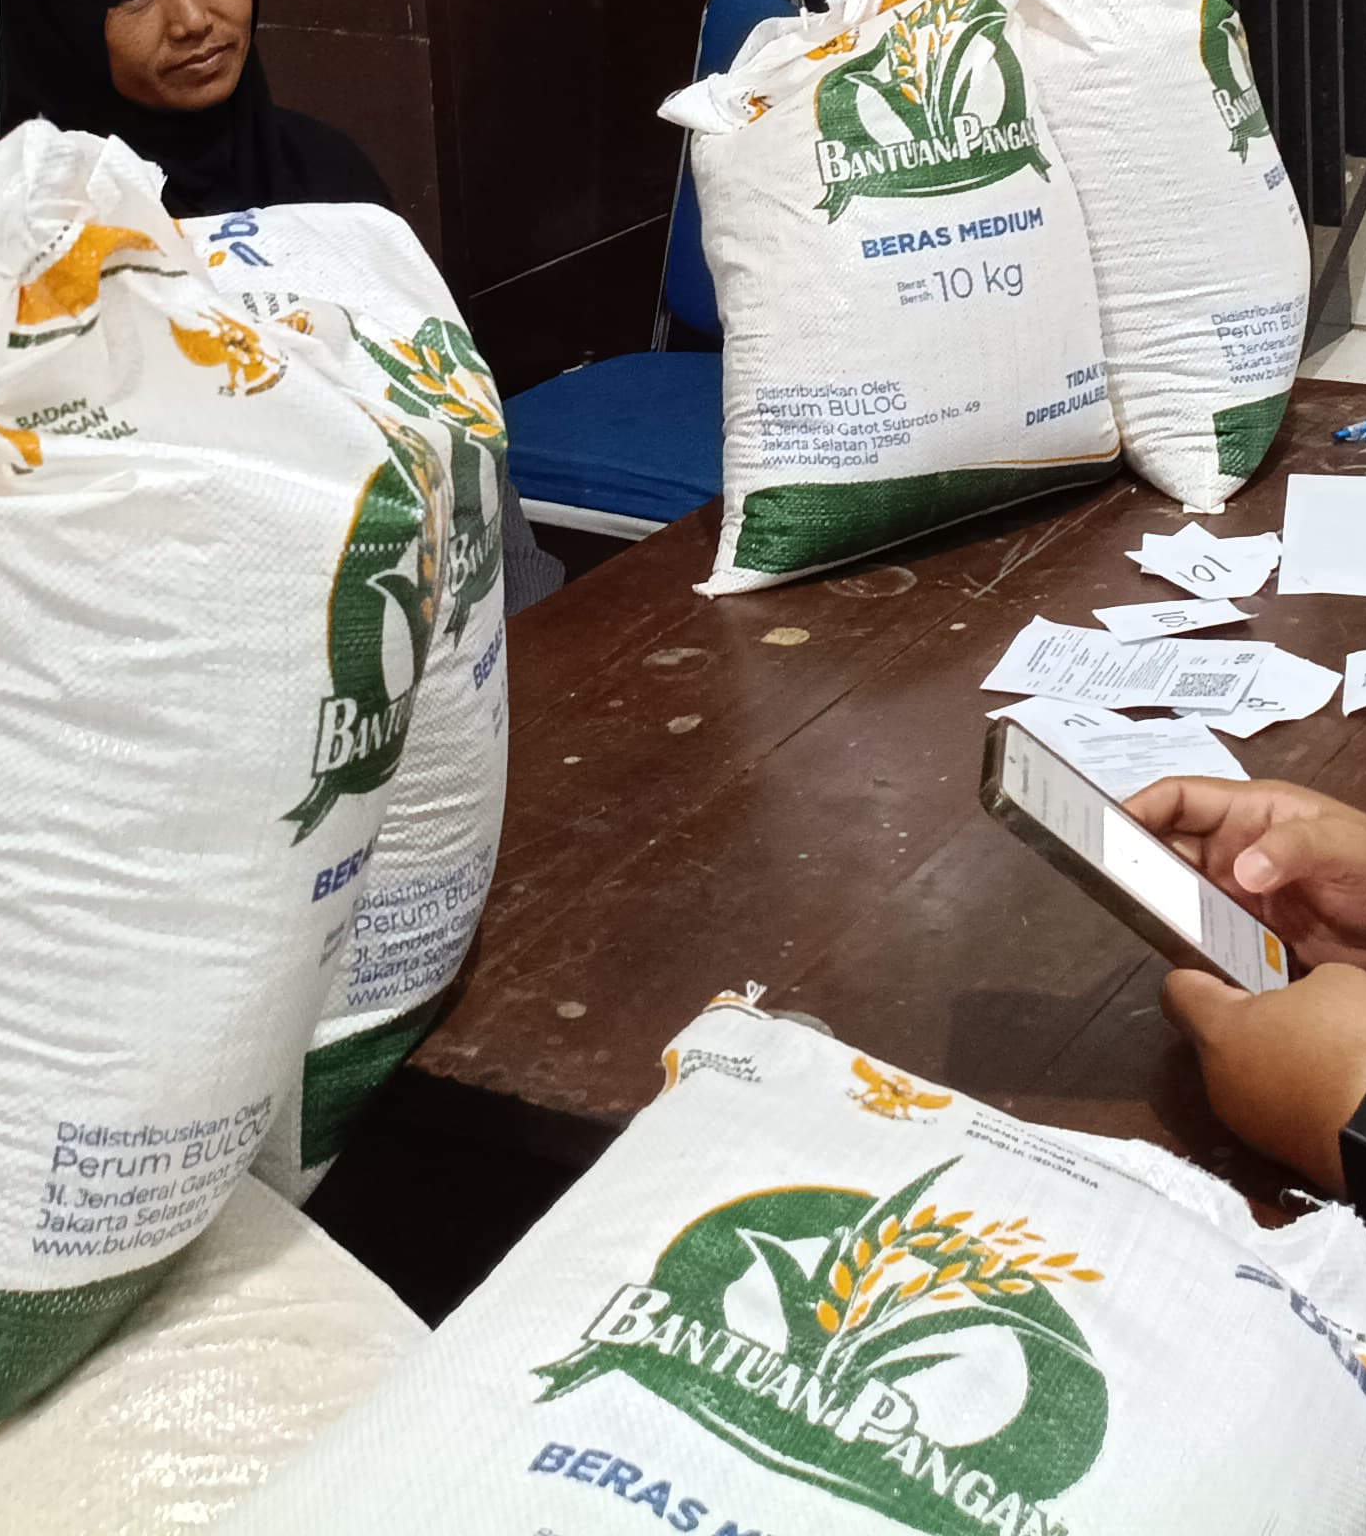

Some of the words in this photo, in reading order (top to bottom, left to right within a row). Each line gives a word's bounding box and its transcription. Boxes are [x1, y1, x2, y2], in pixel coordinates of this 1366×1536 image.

[815, 135, 953, 186] BANTUAN
[861, 226, 953, 259] BERAS
[957, 206, 1045, 243] MEDIUM
[933, 267, 974, 302] 10
[982, 260, 1024, 297] kg
[1216, 319, 1278, 340] Perum
[756, 383, 858, 402] Didistribusikan
[1066, 363, 1099, 389] TIDAK
[757, 401, 823, 418] Perum
[829, 393, 908, 416] BULOG
[838, 421, 880, 436] Gatot
[882, 412, 938, 432] Subroto
[964, 400, 981, 414] 49
[762, 438, 809, 453] Jakarta
[813, 437, 867, 452] Selatan
[871, 431, 911, 449] 12950
[762, 451, 879, 468] www.bulog.co.id
[1175, 554, 1233, 584] 101
[354, 898, 440, 939] Perum
[349, 957, 420, 987] Jakarta
[57, 1116, 230, 1149] Didistribusikan
[51, 1144, 172, 1179] Perum
[75, 1178, 176, 1210] Jenderal
[181, 1164, 231, 1195] Gatot
[36, 1208, 129, 1235] Jakarta
[134, 1193, 207, 1227] Selatan
[581, 1282, 845, 1426] BANTUAN
[528, 1440, 710, 1533] BERAS
